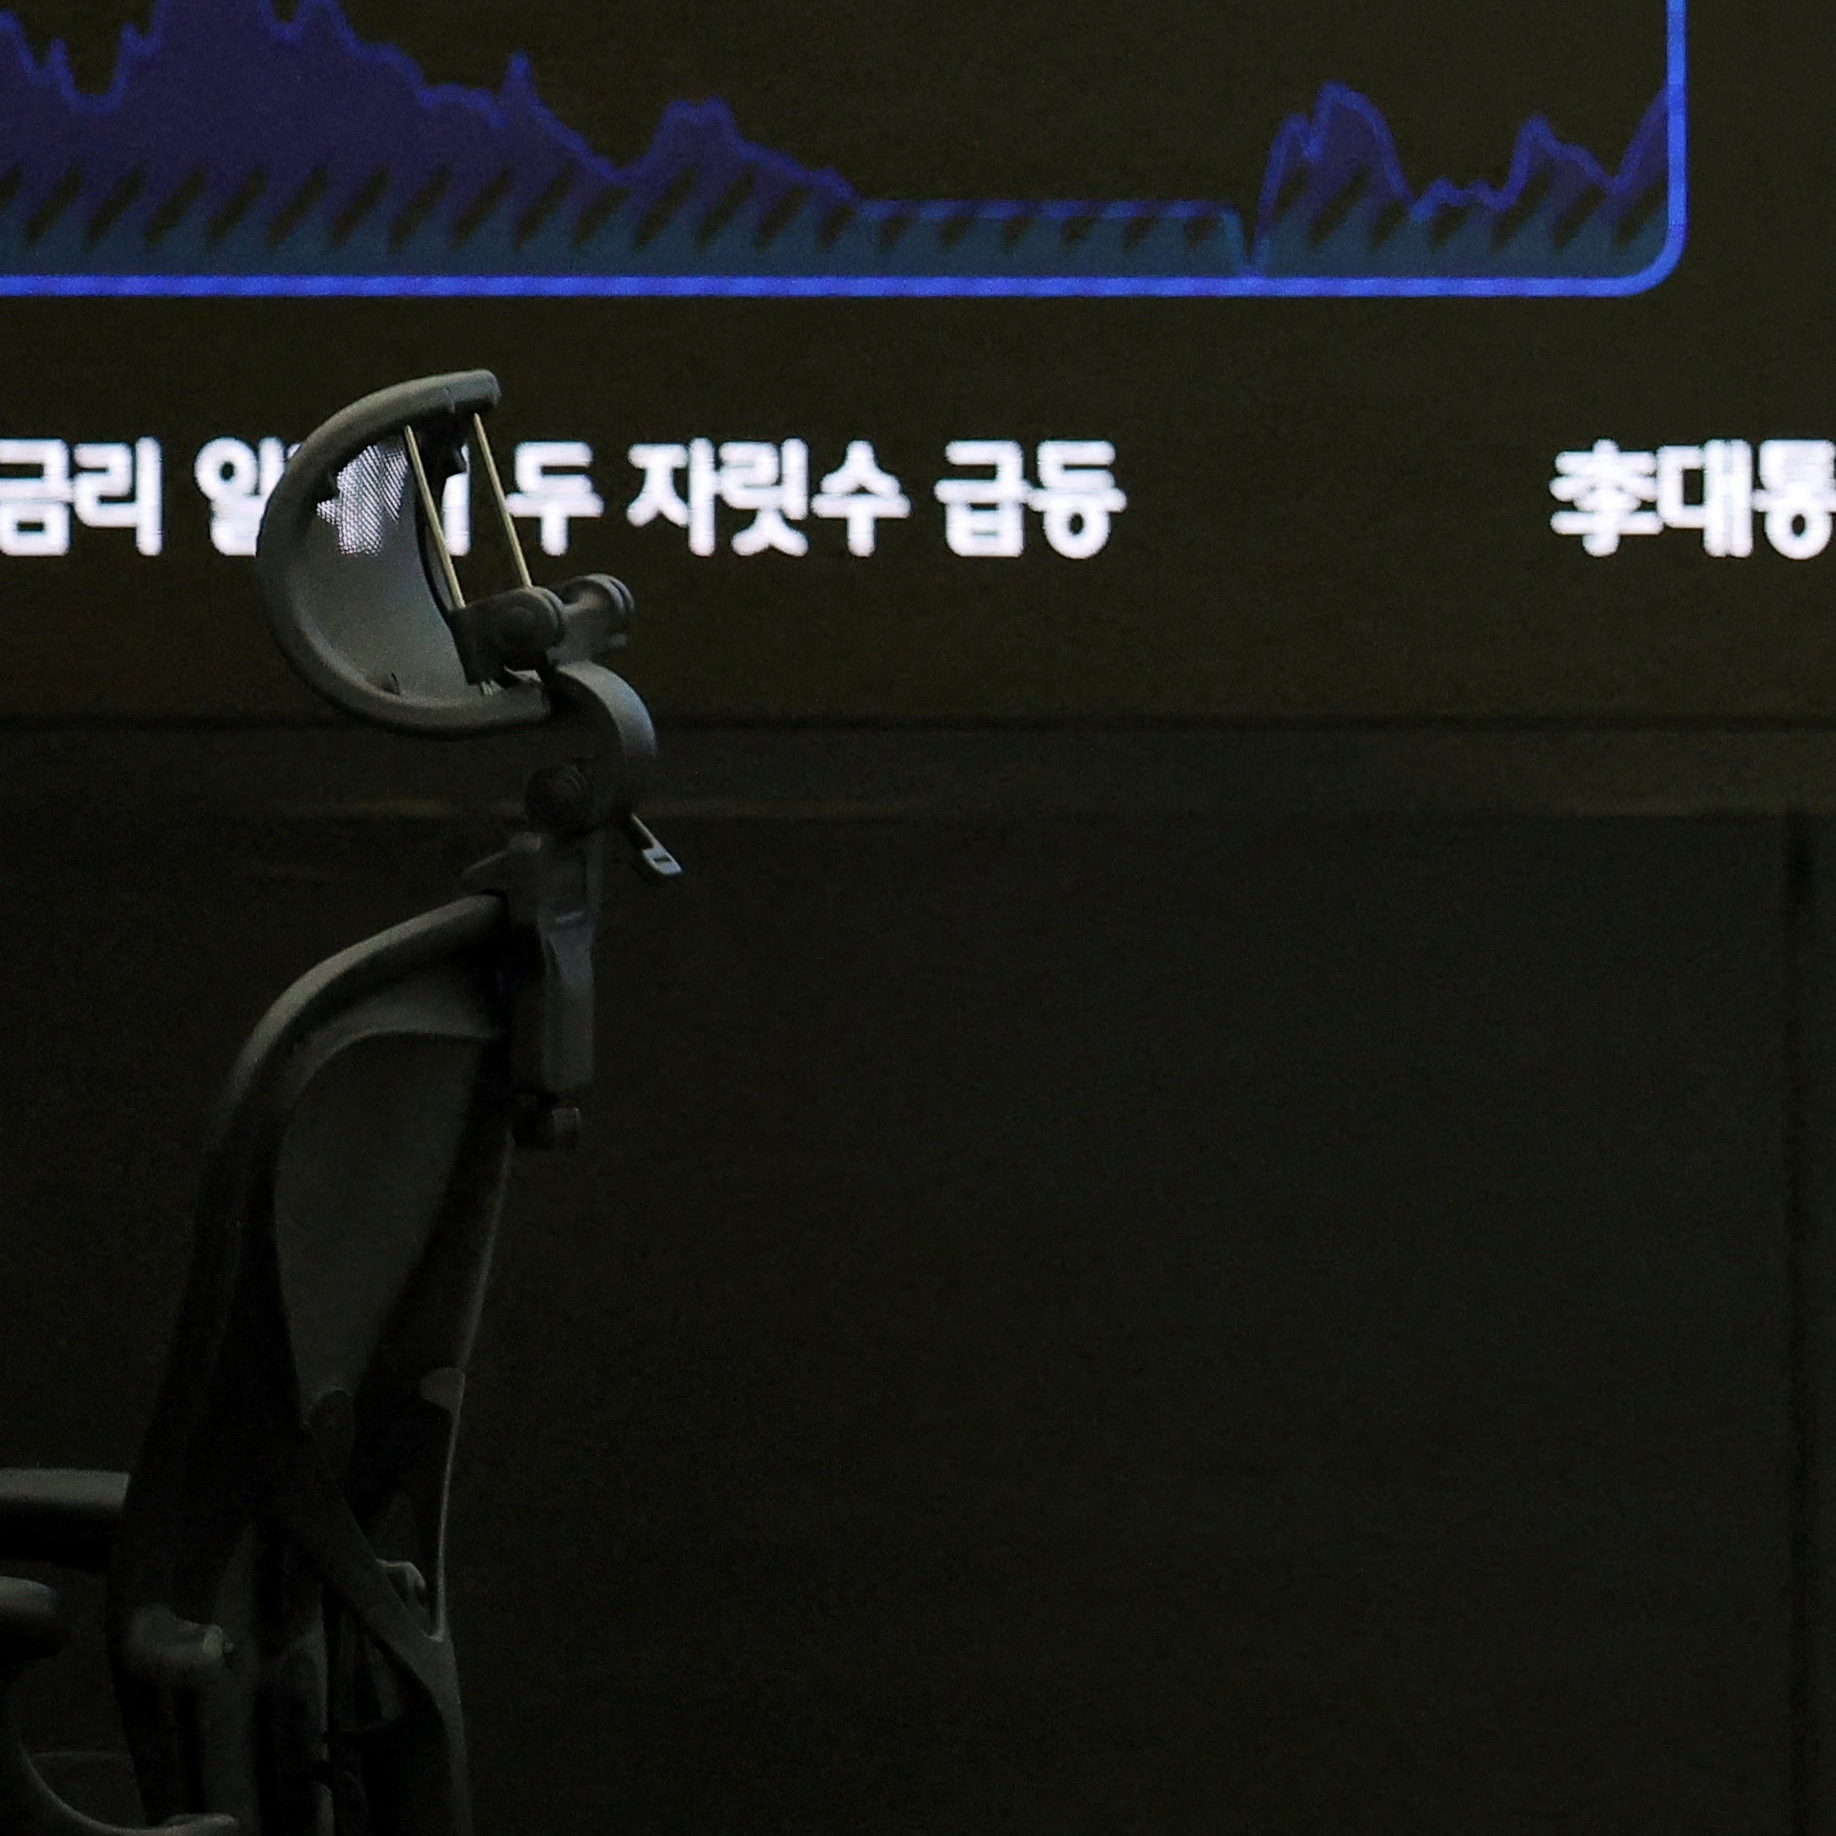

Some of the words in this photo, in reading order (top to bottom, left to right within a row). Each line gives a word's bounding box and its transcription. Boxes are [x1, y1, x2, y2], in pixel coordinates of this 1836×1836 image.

[504, 440, 605, 558] 두
[626, 437, 912, 558] 자릿수
[933, 439, 1128, 560] 급등
